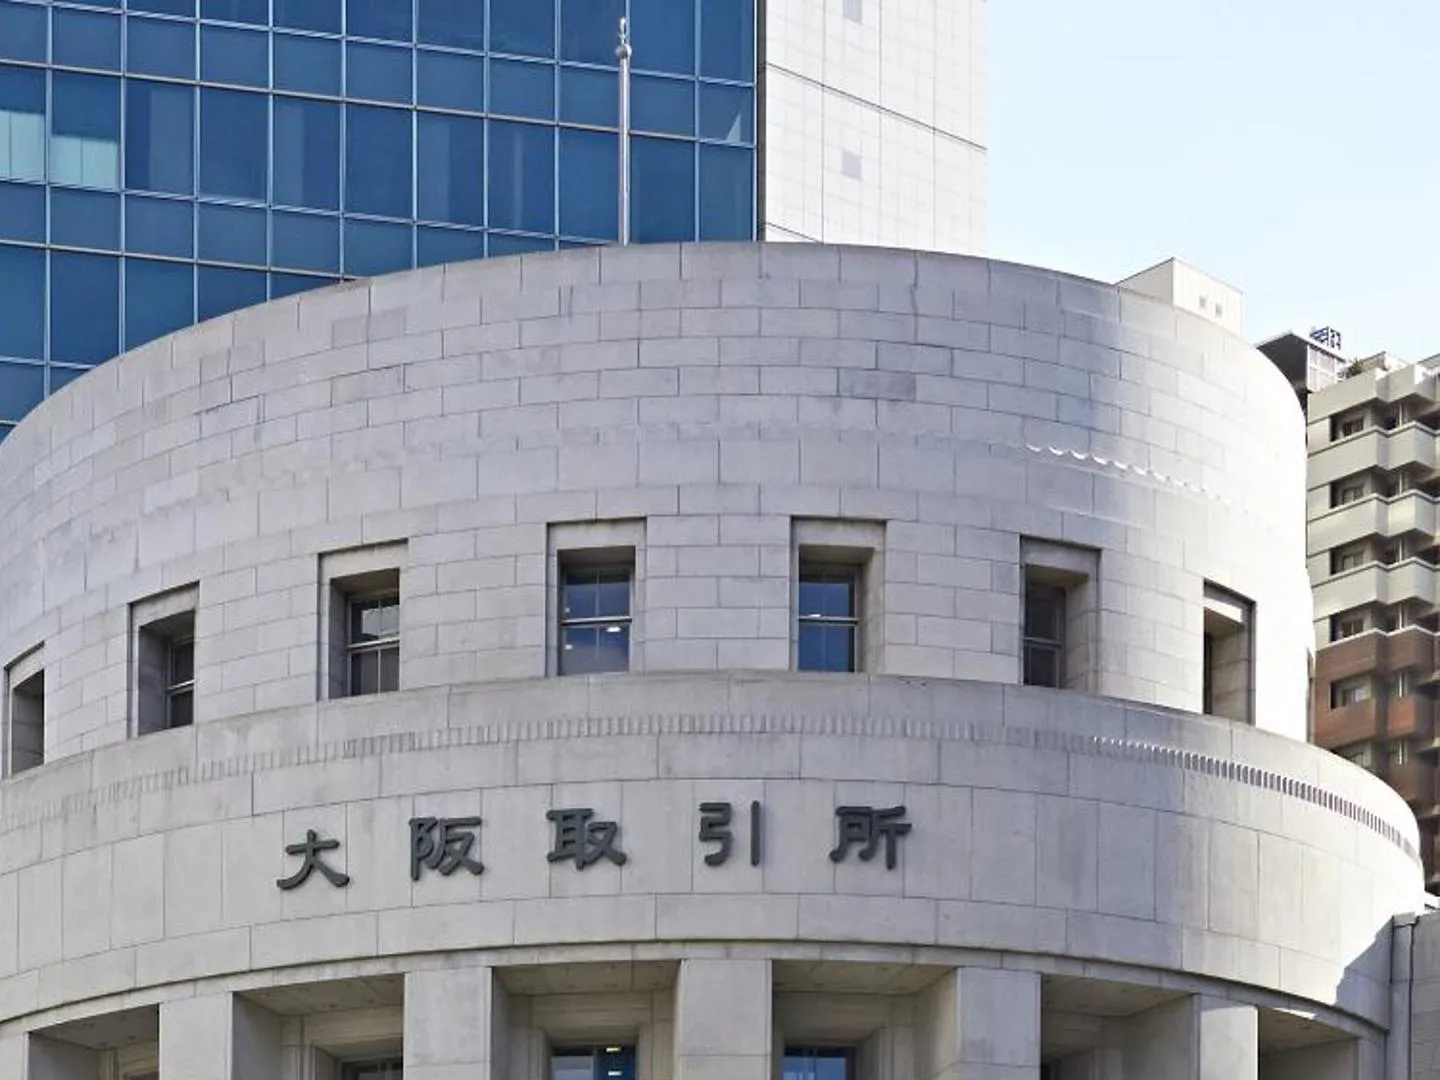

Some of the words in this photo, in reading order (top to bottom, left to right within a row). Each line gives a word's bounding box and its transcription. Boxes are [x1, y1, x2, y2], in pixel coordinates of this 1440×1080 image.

[277, 799, 911, 892] 大阪取引所
